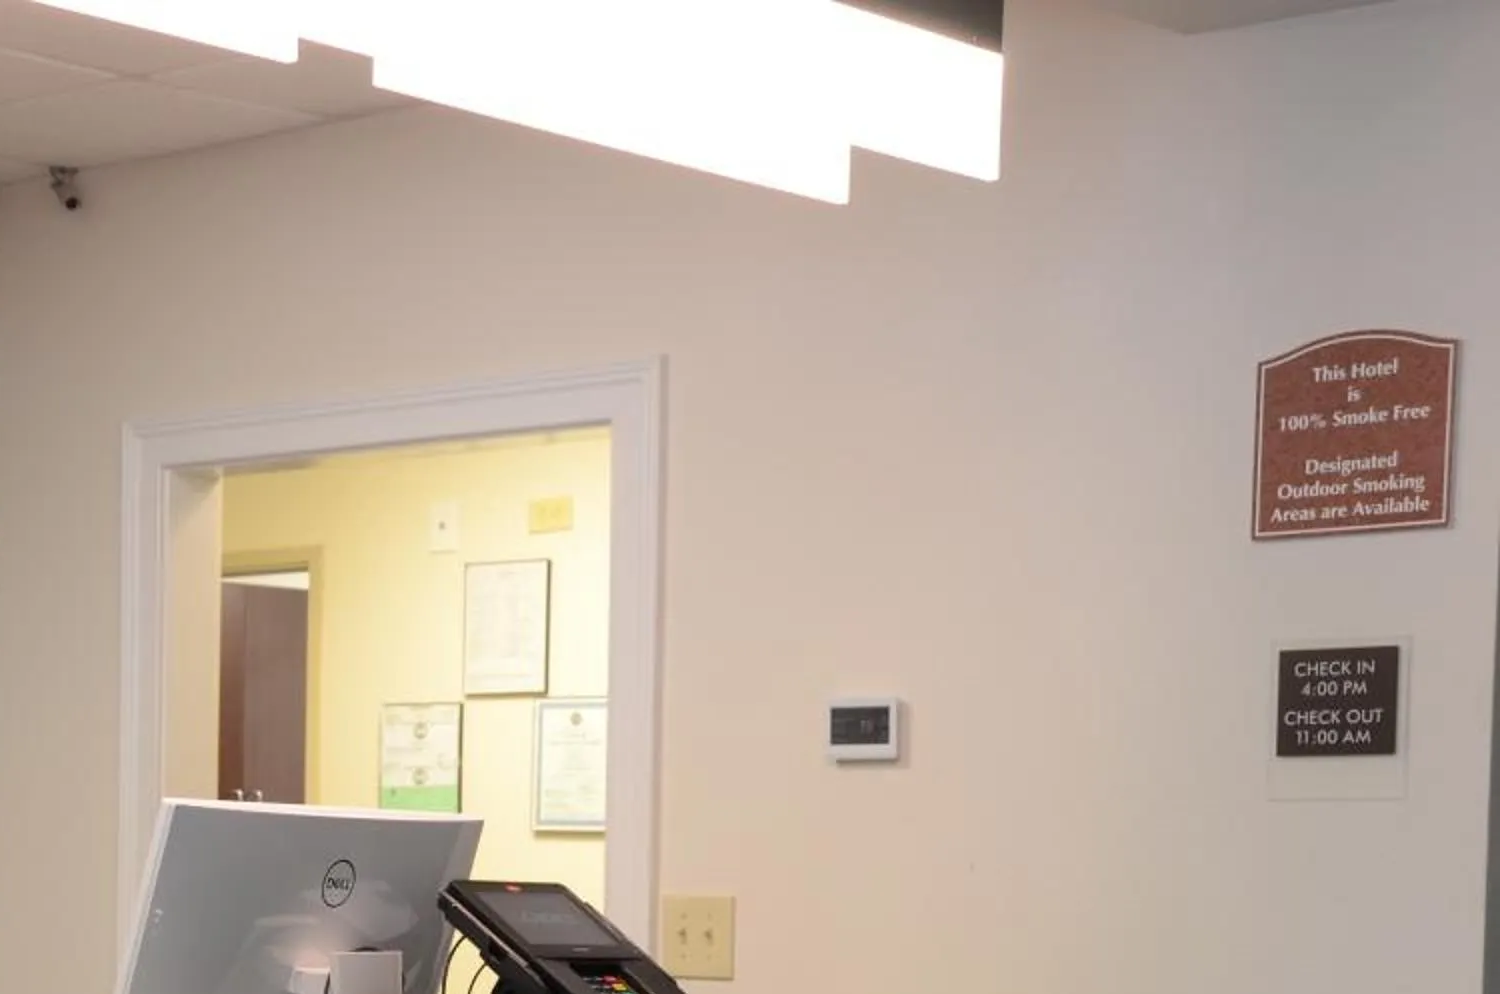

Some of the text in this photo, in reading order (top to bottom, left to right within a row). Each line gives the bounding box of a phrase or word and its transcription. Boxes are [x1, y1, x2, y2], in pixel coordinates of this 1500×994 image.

[1312, 357, 1399, 383] This Hotel
[1347, 385, 1361, 402] is
[1279, 404, 1431, 432] 100% Smoke Free
[1305, 450, 1399, 475] Designated
[1277, 473, 1425, 500] Outdoor Smoking
[1269, 495, 1430, 524] Areas are Available
[1294, 659, 1376, 677] CHECK IN
[1301, 680, 1367, 697] 4:00 PM
[1284, 708, 1384, 726] CHECK OUT
[1295, 730, 1371, 746] 11:00 AM
